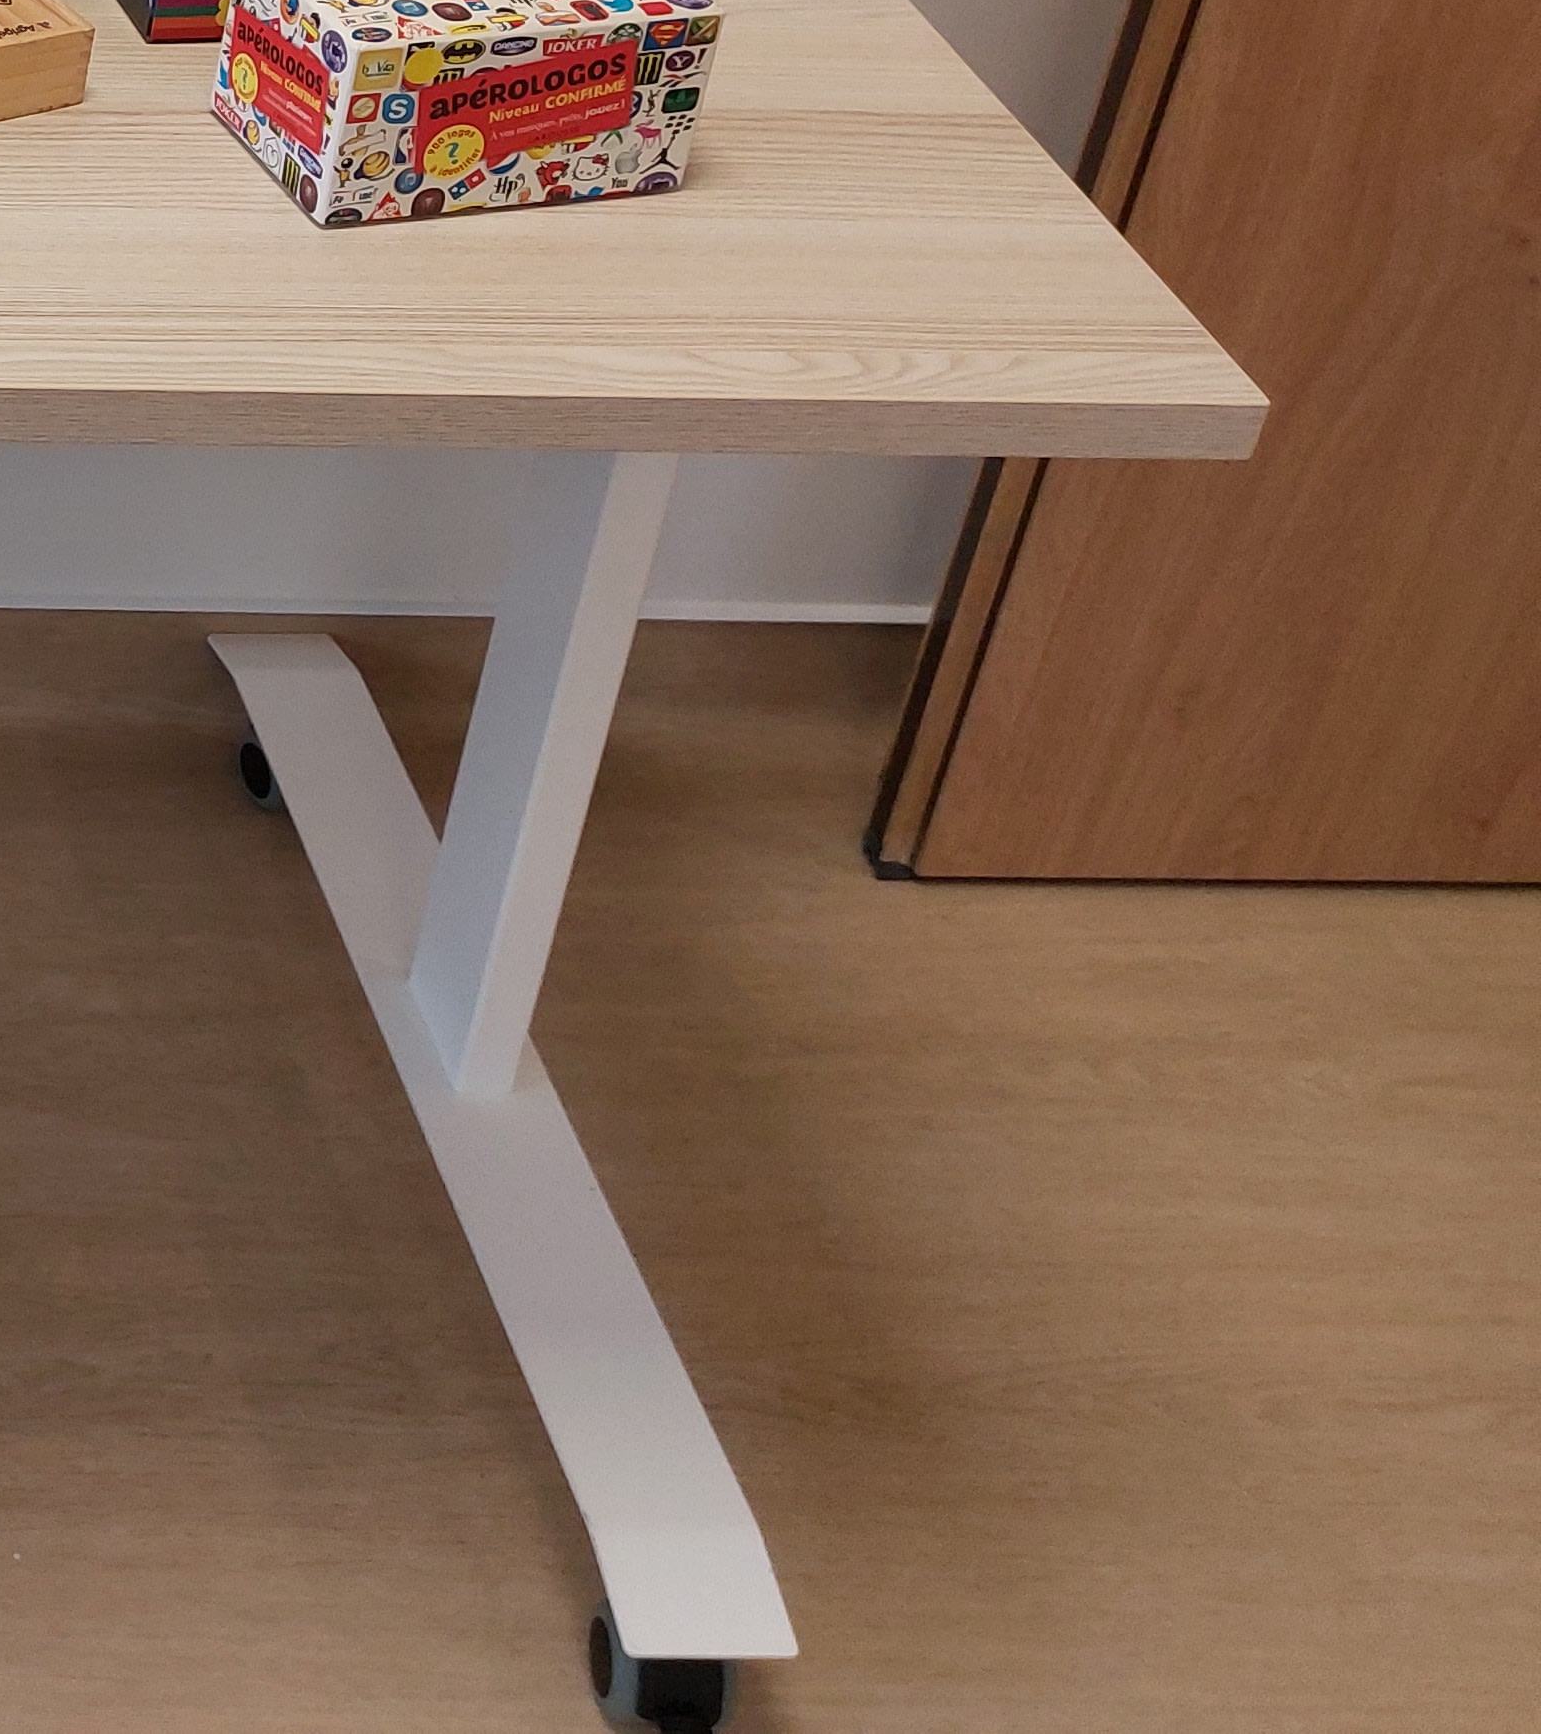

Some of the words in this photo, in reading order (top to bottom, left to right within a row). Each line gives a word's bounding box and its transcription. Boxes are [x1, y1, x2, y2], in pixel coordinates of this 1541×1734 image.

[493, 39, 535, 52] DANONE
[545, 37, 599, 55] JOKER
[488, 102, 540, 124] Niveau
[544, 76, 627, 110] CONFIRMÉ
[584, 102, 620, 121] jouez
